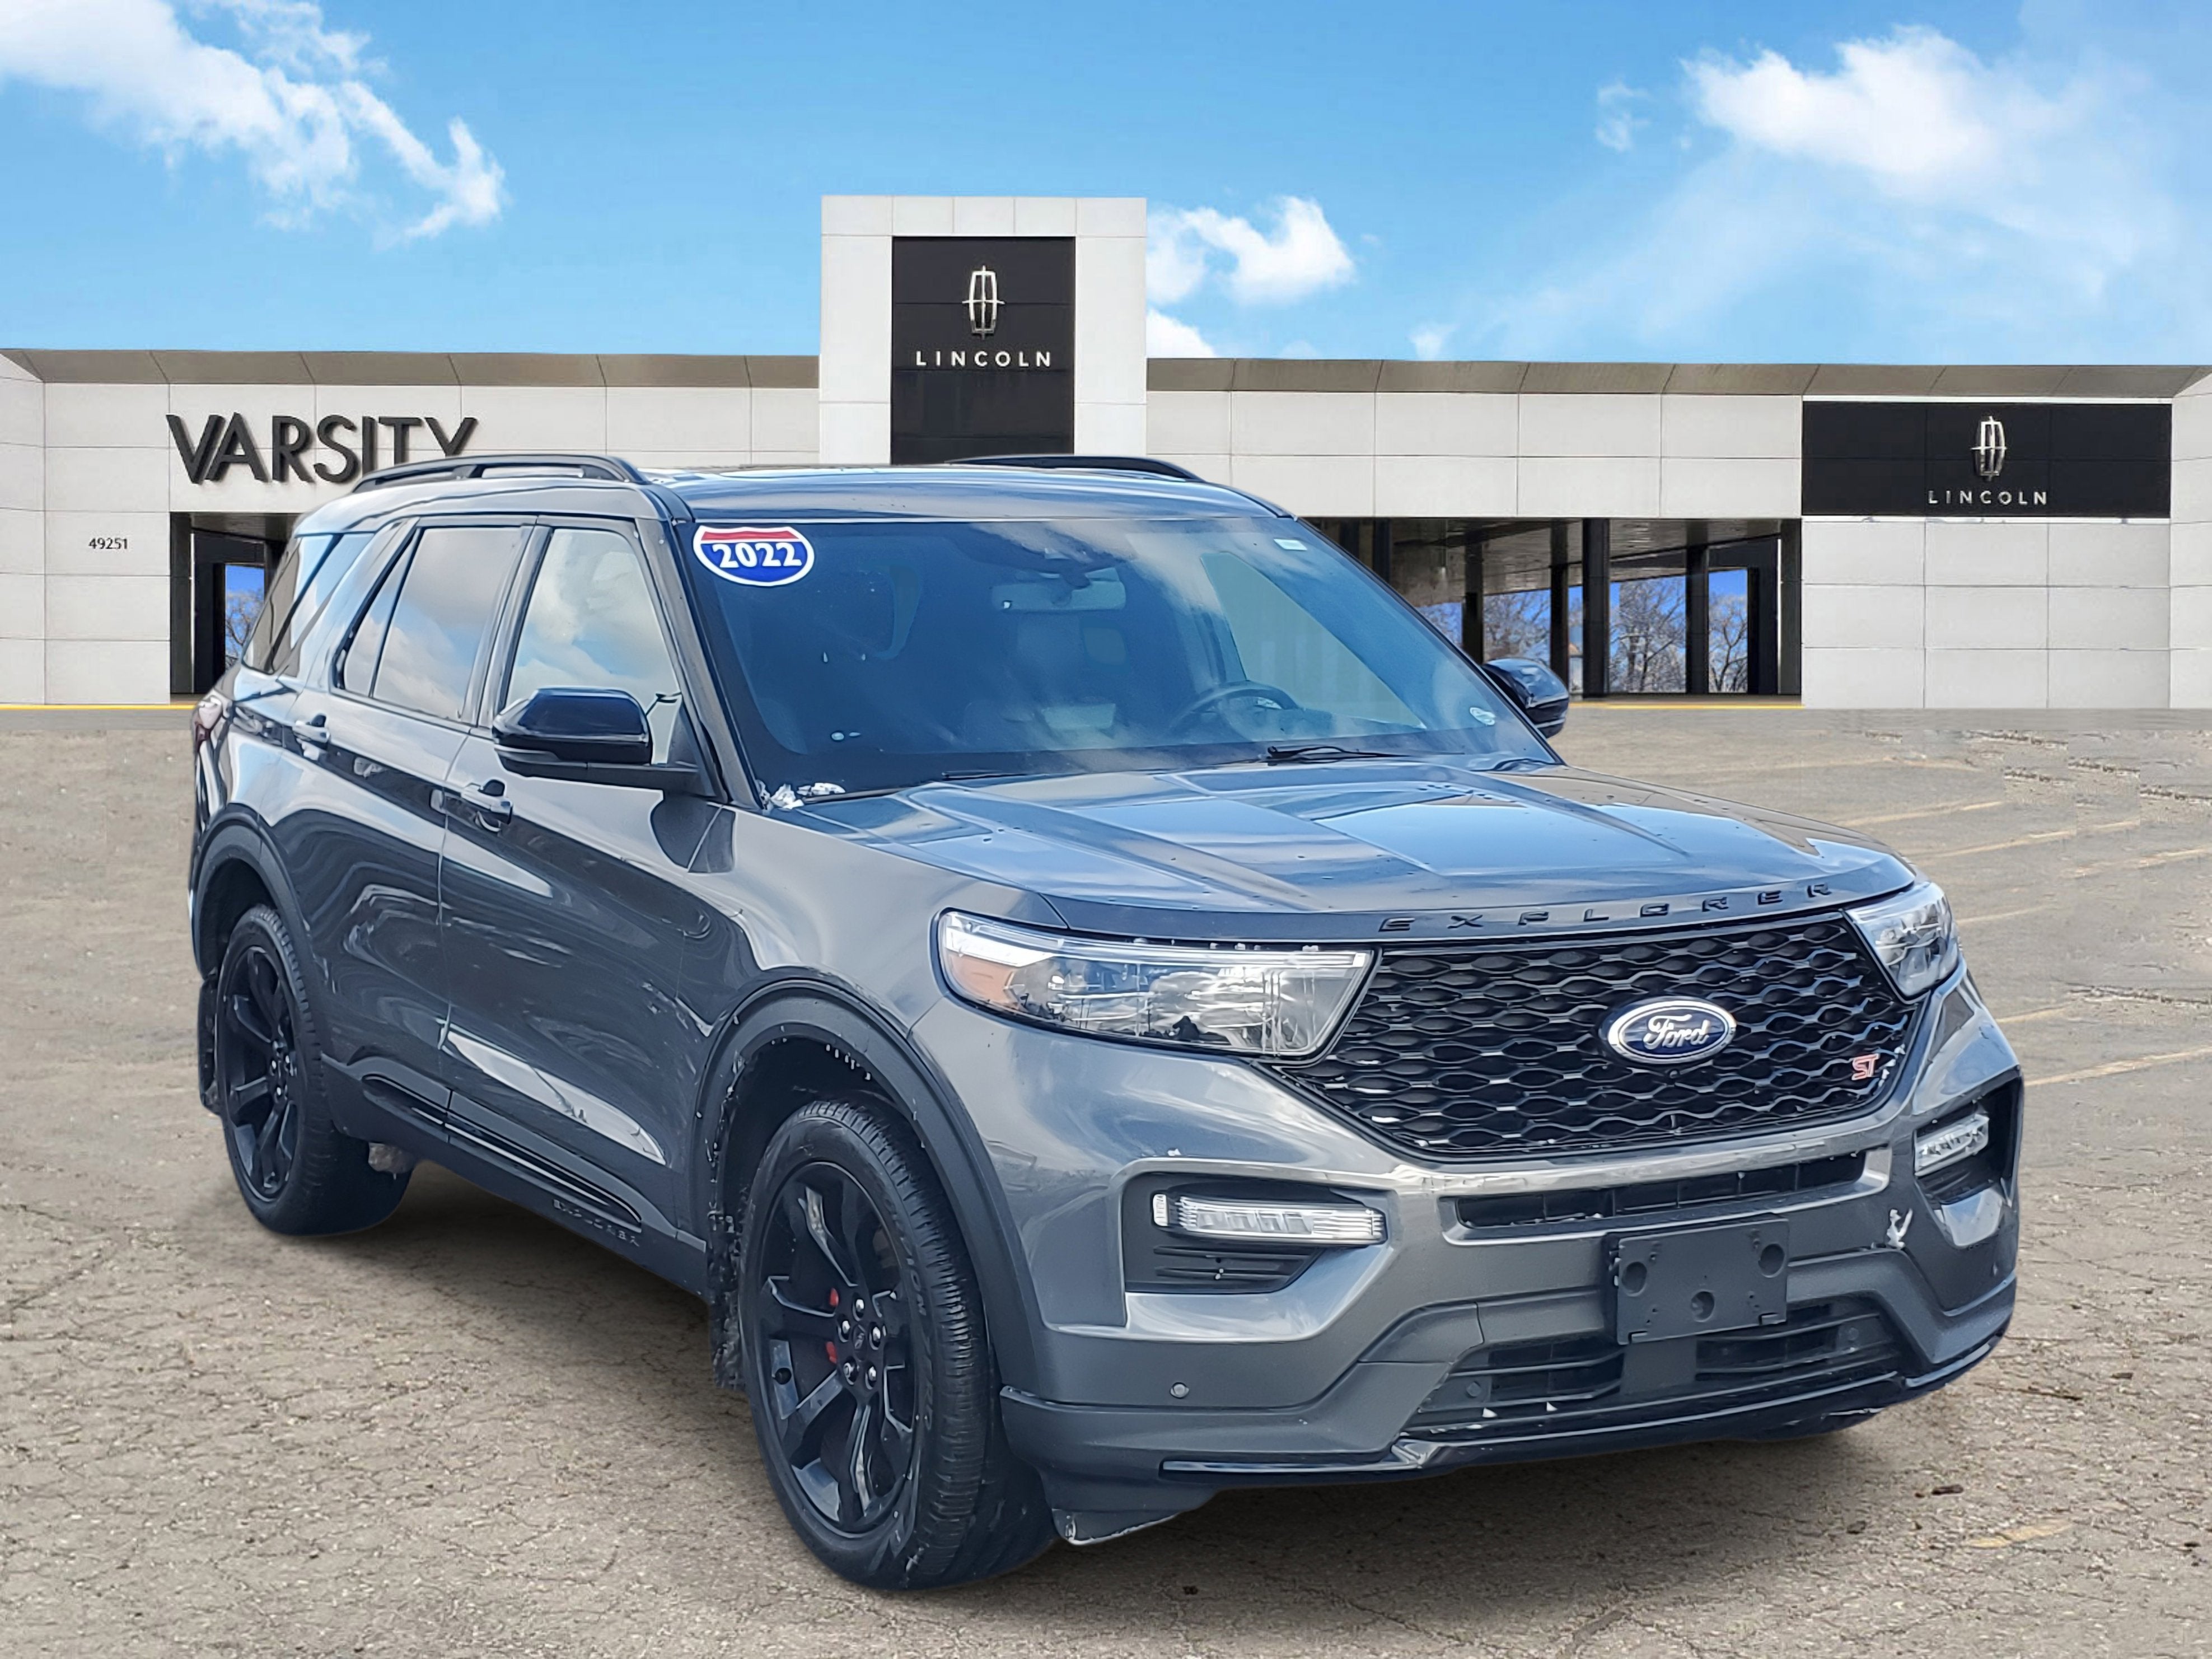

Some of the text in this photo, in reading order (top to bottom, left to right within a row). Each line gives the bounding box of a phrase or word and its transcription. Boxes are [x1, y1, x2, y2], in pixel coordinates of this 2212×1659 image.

[915, 351, 1051, 367] LINCOLN
[166, 412, 478, 485] VARSITY
[1928, 490, 2047, 505] LINCOLN
[88, 537, 128, 549] 49251
[712, 541, 803, 568] 2022
[1378, 884, 1832, 932] EXPLORER
[1643, 1013, 1710, 1050] Ford
[1851, 1053, 1879, 1081] ST
